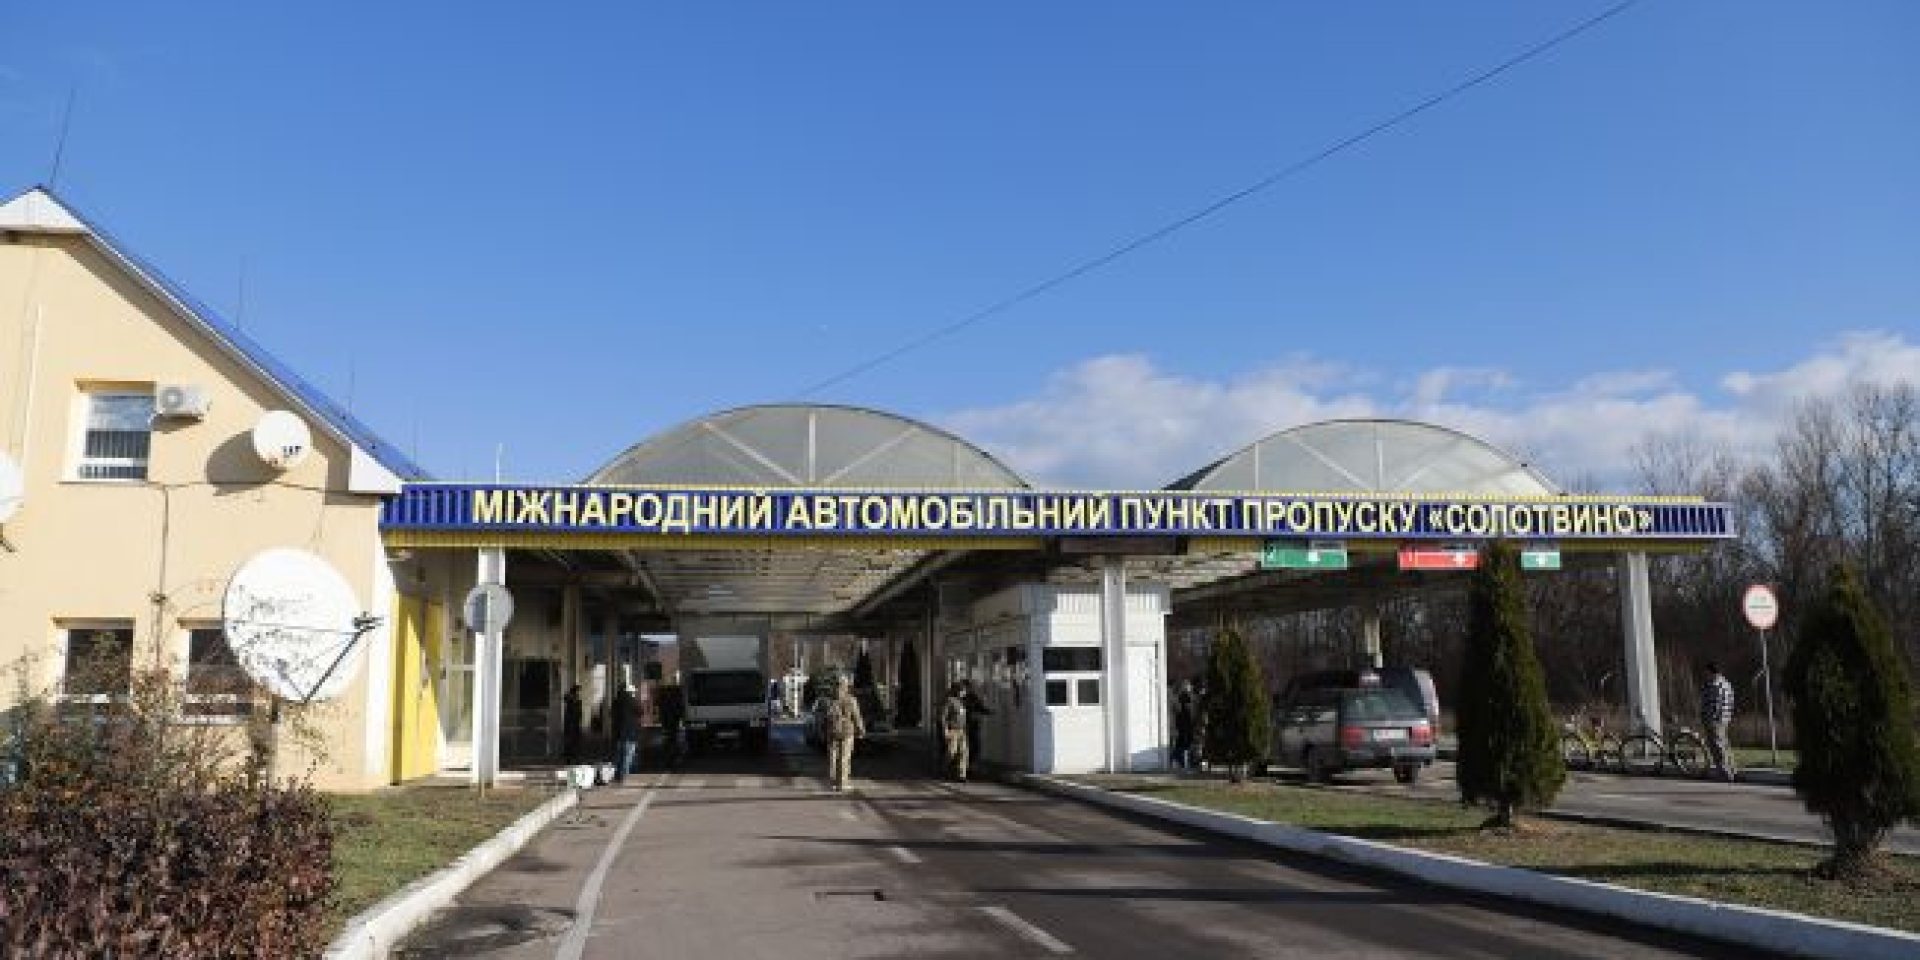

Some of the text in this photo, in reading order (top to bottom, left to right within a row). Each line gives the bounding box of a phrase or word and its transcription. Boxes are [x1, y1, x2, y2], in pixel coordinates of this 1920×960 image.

[473, 489, 1651, 534] МІЖНАРОДНИЙ АВТОМОБІЛЬНИЙ ПУНКТ ПРОПУСКУ «СОЛОТВИНО»
